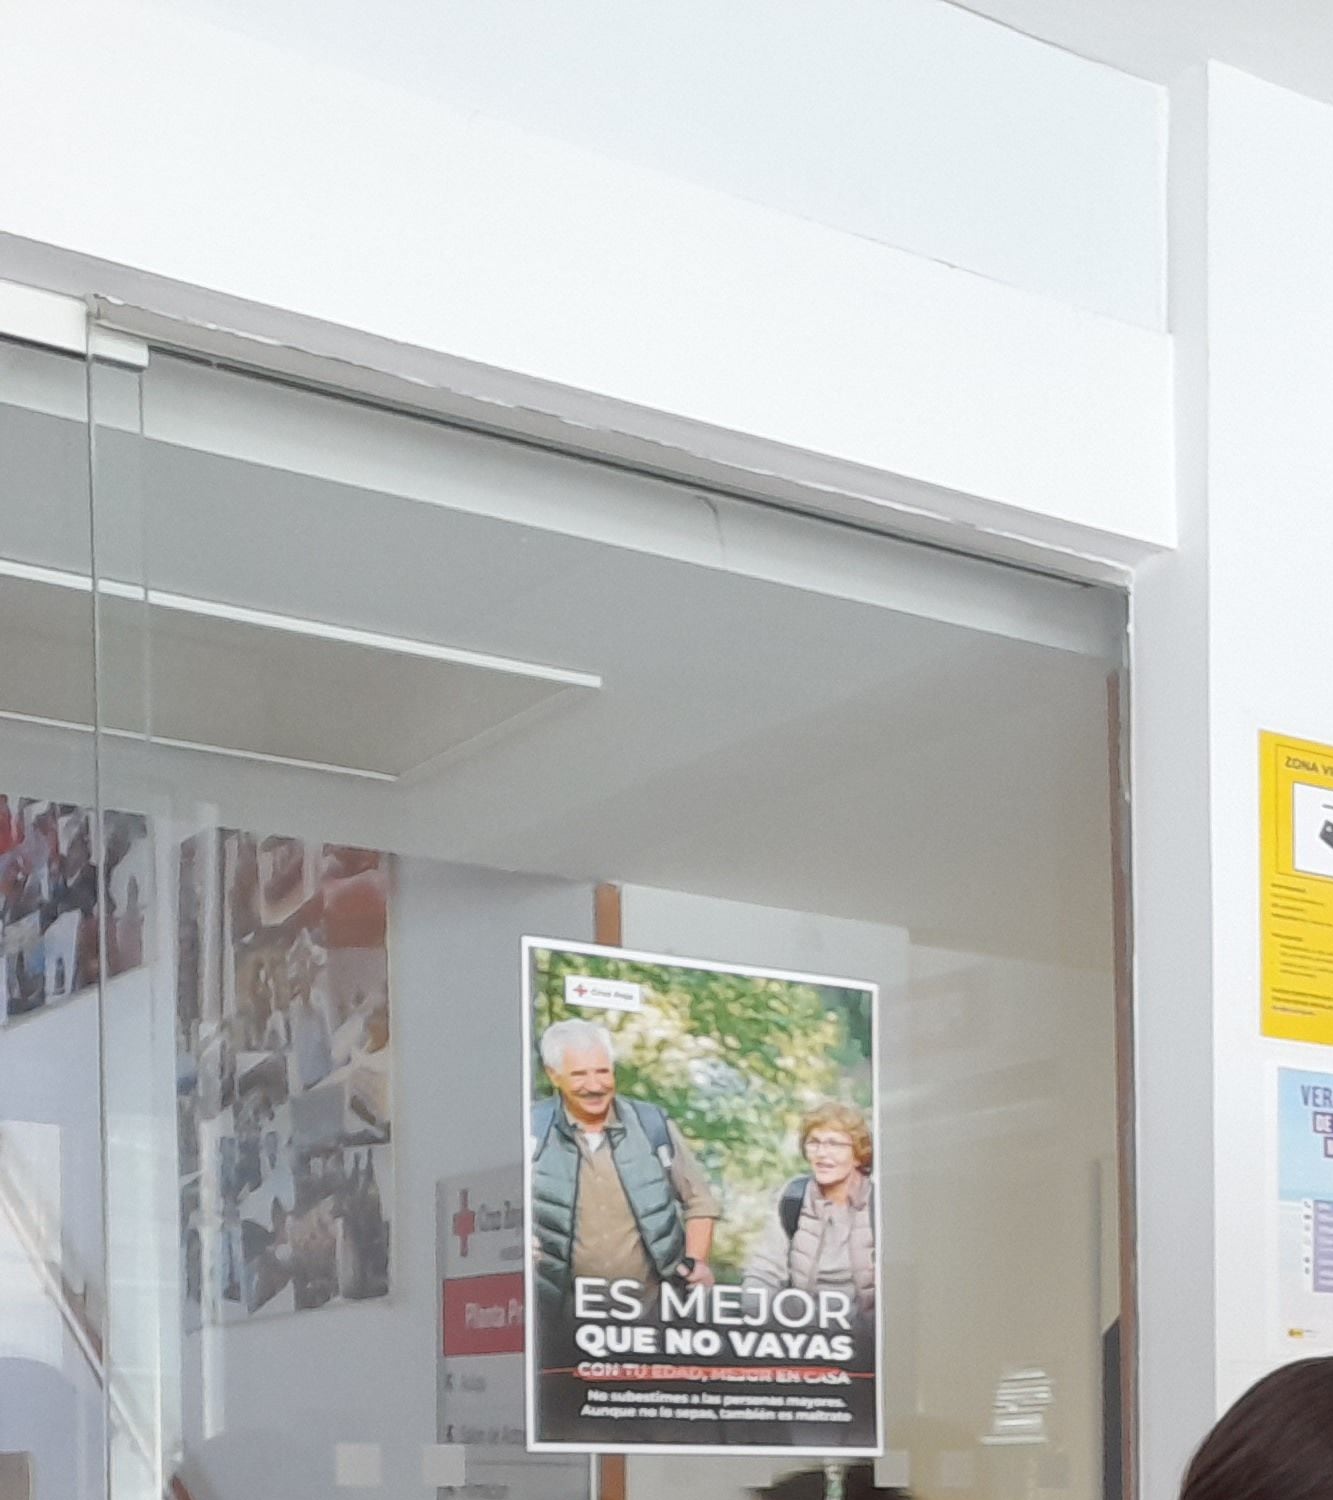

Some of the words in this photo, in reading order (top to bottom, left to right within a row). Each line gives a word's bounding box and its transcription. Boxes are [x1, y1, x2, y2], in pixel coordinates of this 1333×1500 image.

[1285, 756, 1319, 774] ZONA
[1315, 1114, 1332, 1134] DE
[574, 1276, 643, 1321] ES
[659, 1281, 851, 1330] MEJOR
[575, 1324, 658, 1357] QUE
[664, 1328, 722, 1357] NO
[728, 1331, 854, 1361] VAYAS
[577, 1361, 620, 1378] CON
[622, 1362, 650, 1379] TU
[775, 1369, 801, 1383] EN
[803, 1369, 851, 1385] CASA
[587, 1388, 609, 1403] No
[580, 1404, 636, 1420] Aunque
